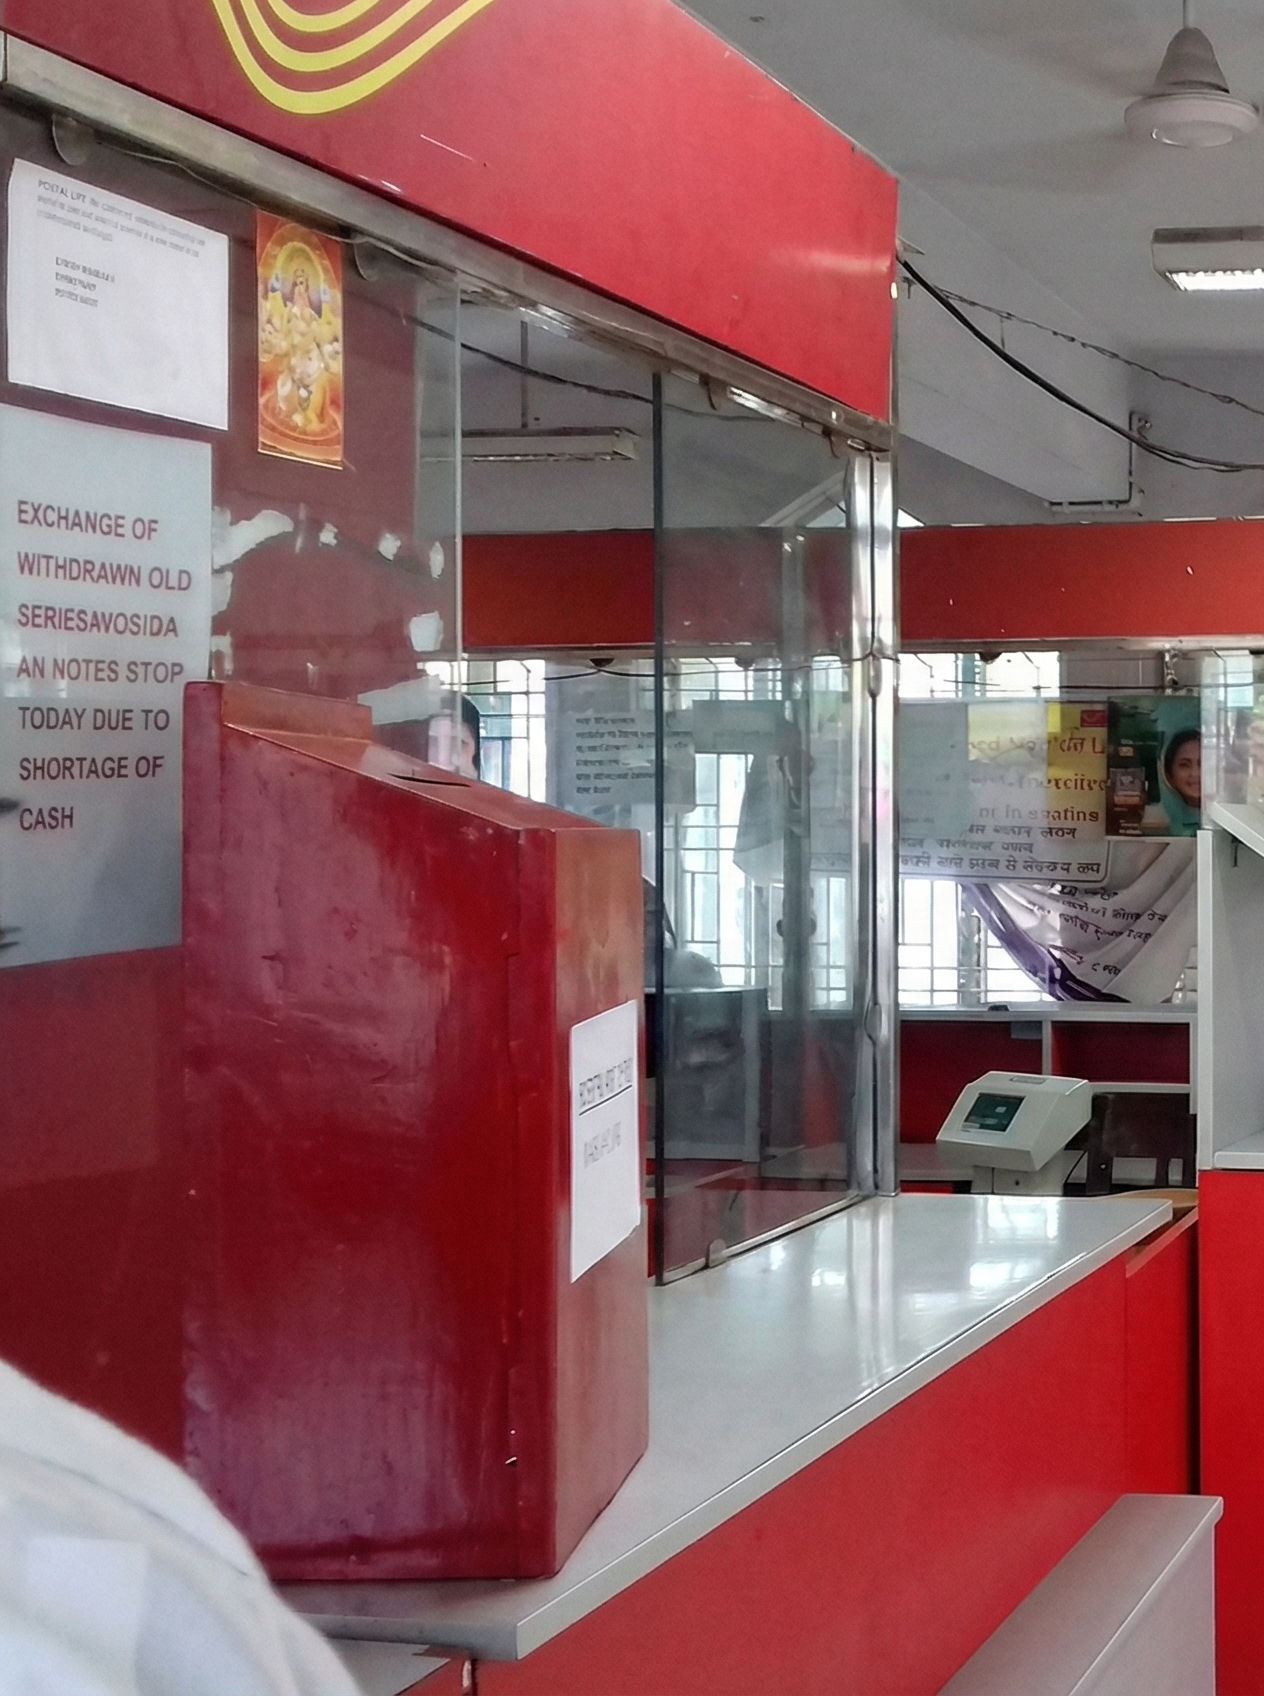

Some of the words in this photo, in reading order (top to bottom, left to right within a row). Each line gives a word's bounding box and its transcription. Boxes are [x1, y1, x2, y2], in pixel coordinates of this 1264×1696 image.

[17, 500, 126, 538] EXCHANGE
[132, 517, 159, 541] OF
[17, 551, 141, 588] WITHDRAWN
[148, 566, 192, 591] OLD
[17, 655, 45, 679] AN
[52, 657, 119, 683] NOTES
[126, 660, 184, 684] STOP
[18, 706, 86, 730] TODAY
[93, 708, 133, 731] DUE
[141, 708, 170, 731] TO
[19, 756, 128, 781] SHORTAGE
[135, 755, 165, 778] OF
[19, 806, 74, 831] CASH
